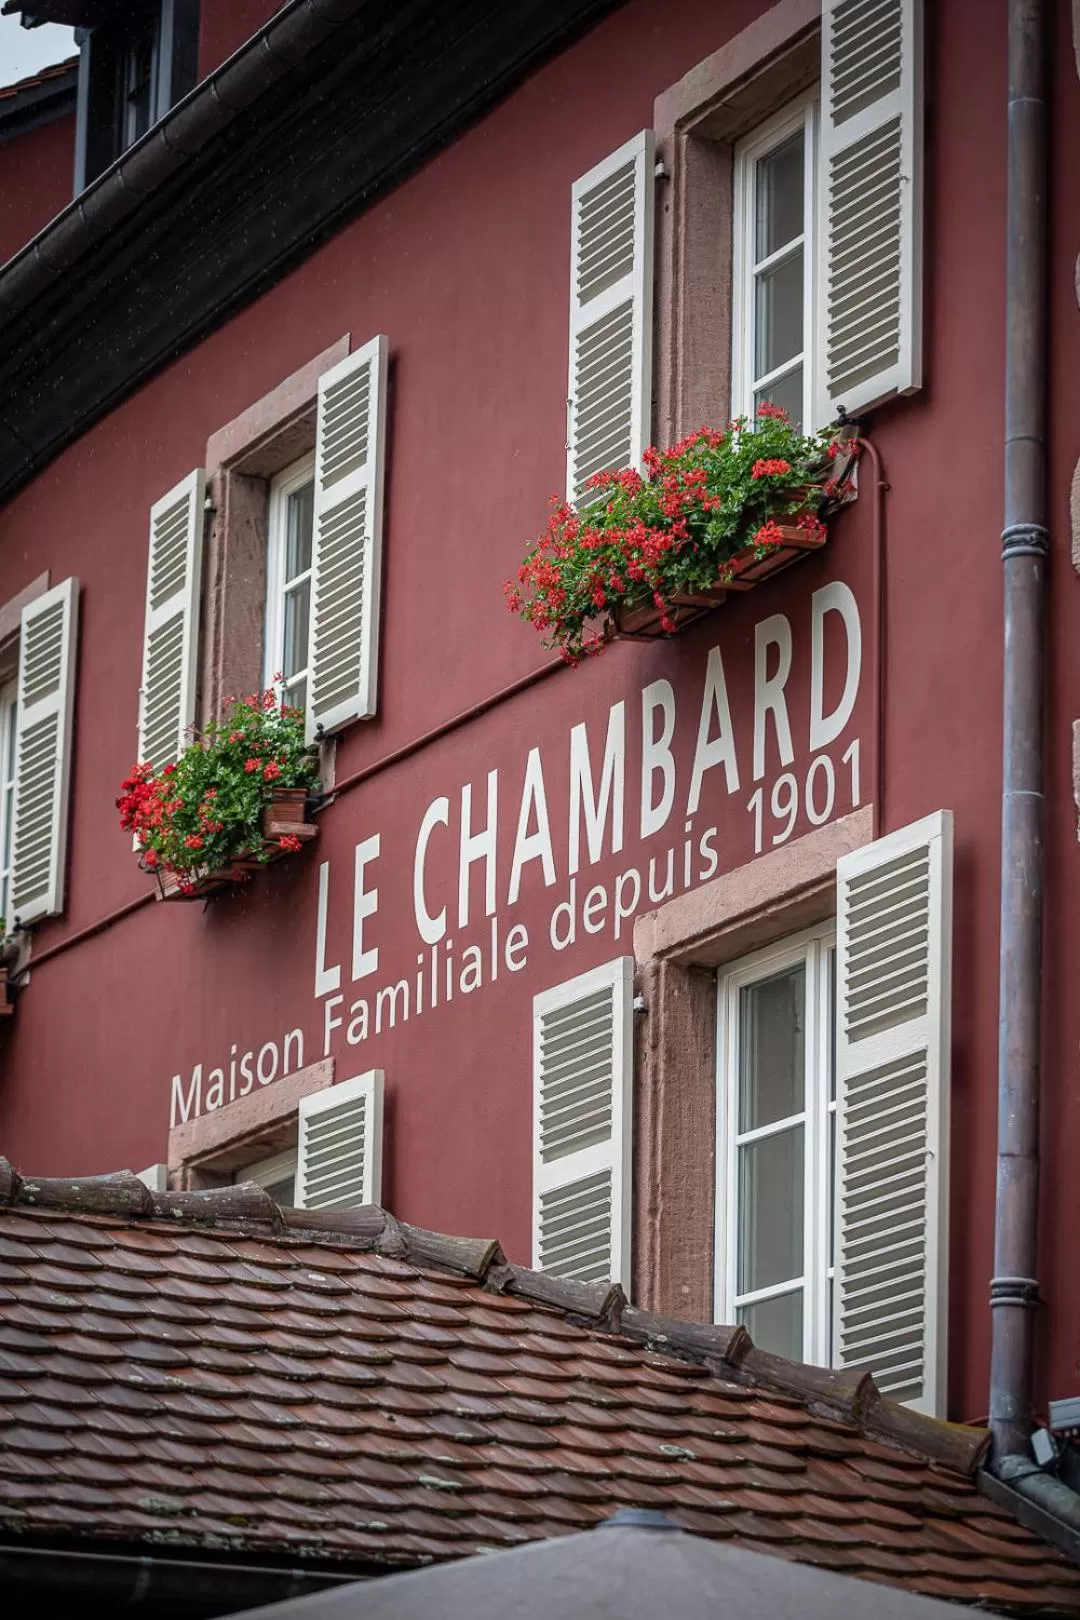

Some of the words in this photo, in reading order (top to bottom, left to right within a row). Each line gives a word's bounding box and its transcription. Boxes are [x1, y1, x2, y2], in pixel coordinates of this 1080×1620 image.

[168, 1027, 305, 1129] Maison
[323, 917, 529, 1057] Familiale
[549, 819, 719, 952] depuis
[745, 738, 861, 855] 1901
[313, 832, 381, 999] LE
[412, 580, 862, 946] CHAMBARD
